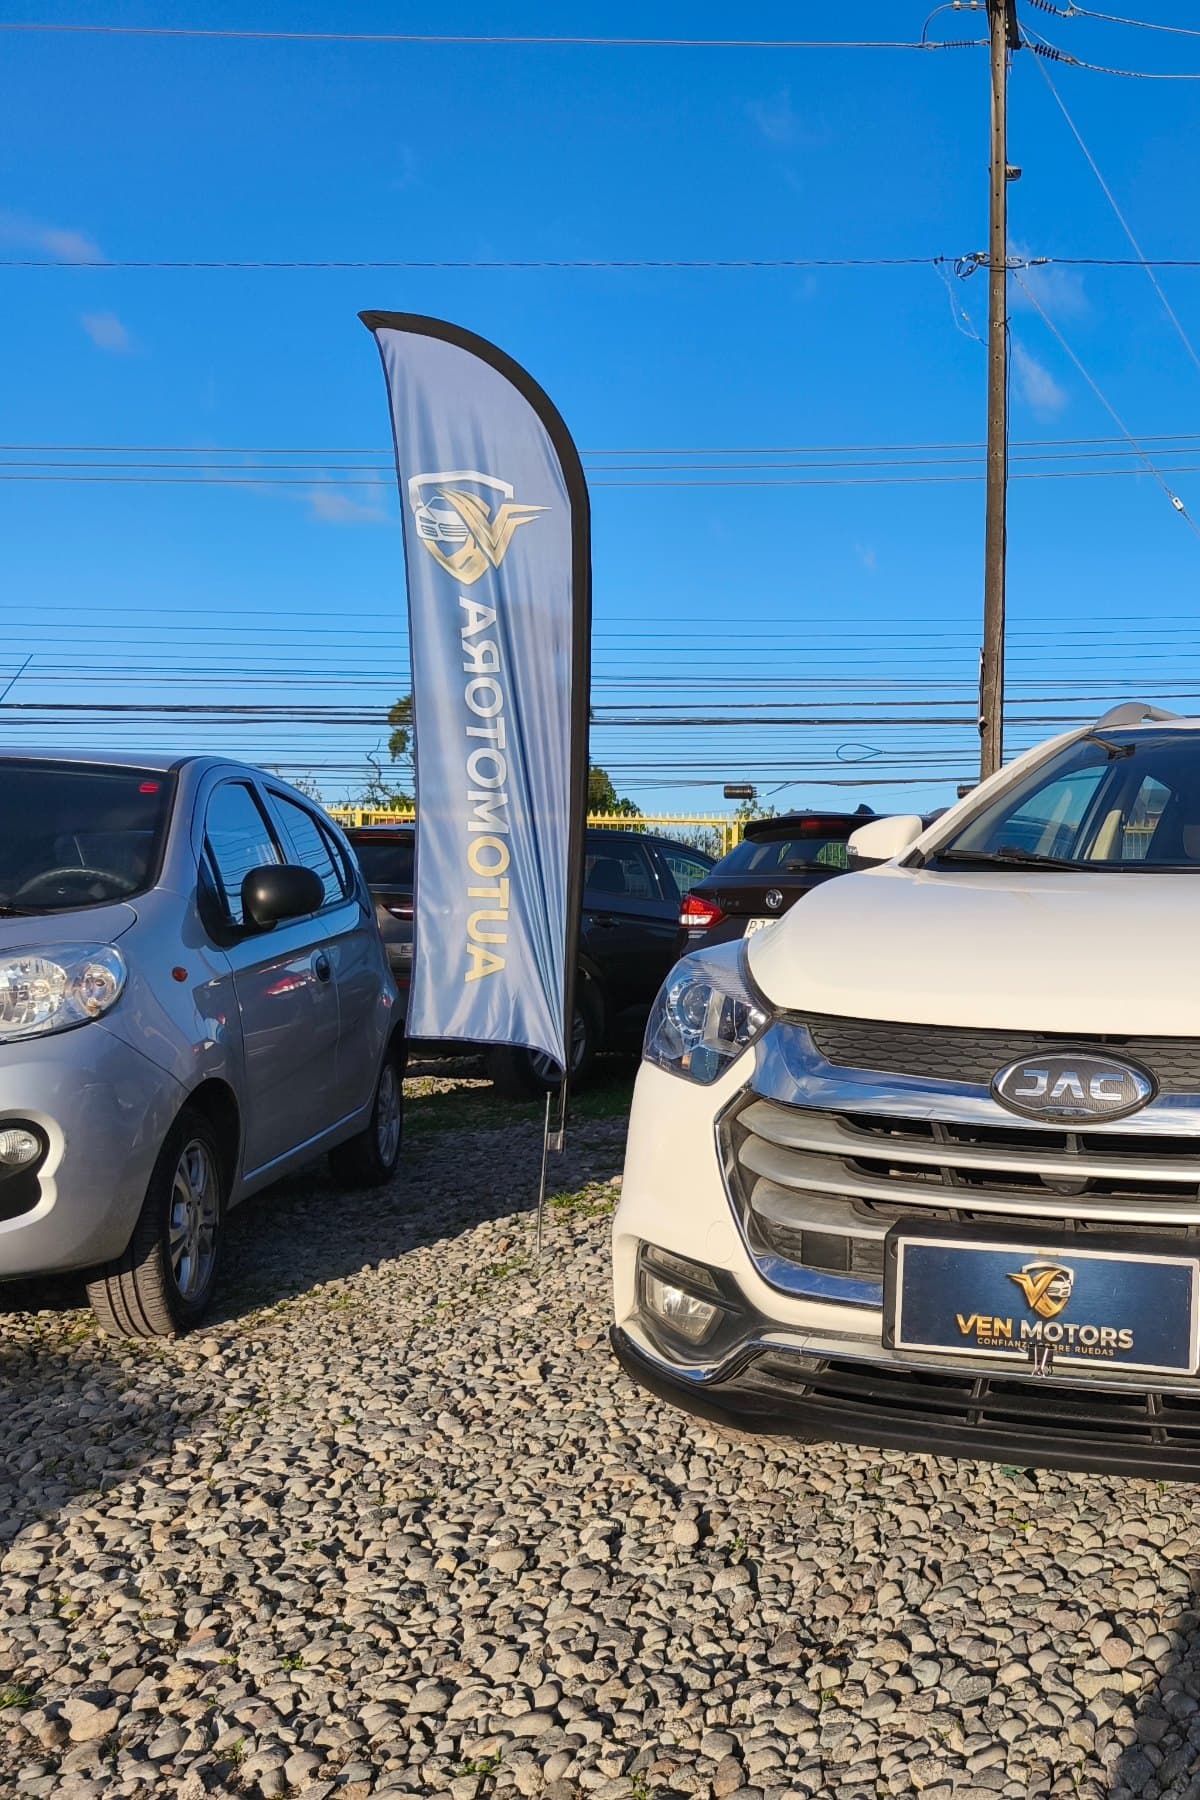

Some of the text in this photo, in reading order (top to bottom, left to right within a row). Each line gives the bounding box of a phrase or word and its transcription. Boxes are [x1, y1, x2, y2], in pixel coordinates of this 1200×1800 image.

[1015, 1069, 1124, 1100] JAC
[956, 1313, 1134, 1349] VEN MOTORS
[977, 1337, 1033, 1350] CONFIANZ
[1074, 1345, 1114, 1357] RUEDAS
